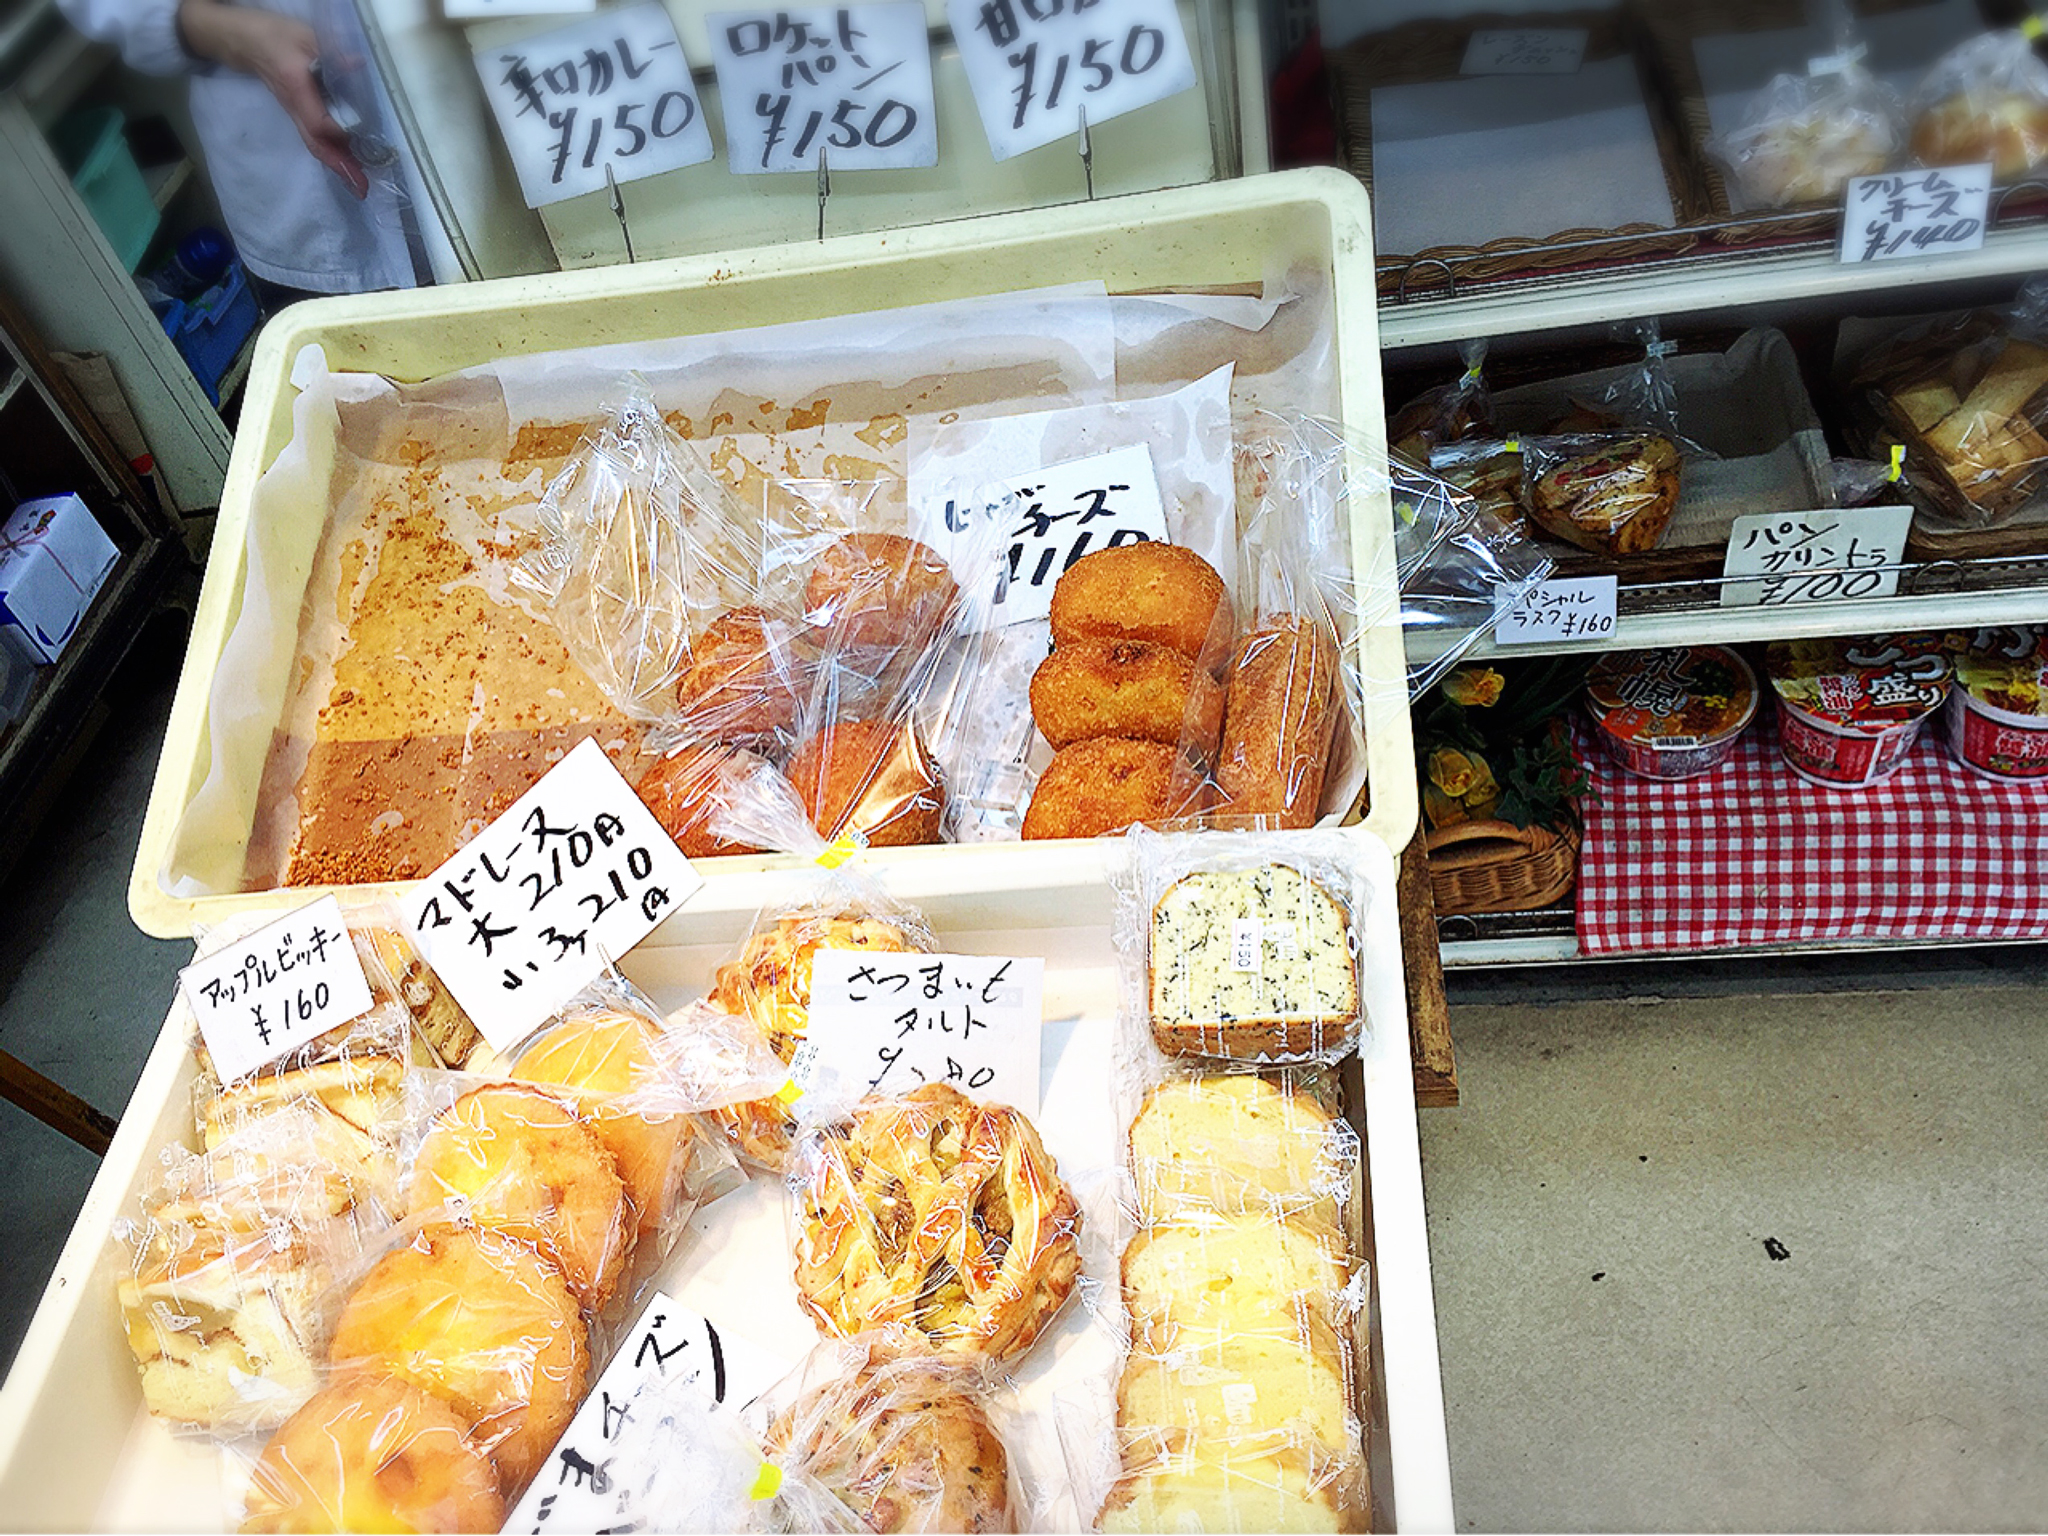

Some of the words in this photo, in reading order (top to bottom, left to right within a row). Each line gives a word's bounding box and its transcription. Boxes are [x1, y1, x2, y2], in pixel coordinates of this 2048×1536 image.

[781, 54, 907, 90] パン
[1007, 24, 1165, 129] ¥150
[547, 91, 694, 184] ¥150
[755, 93, 917, 168] ¥150
[1859, 171, 1955, 203] クリーム
[1880, 186, 1984, 222] チーズ
[1861, 218, 1980, 262] ¥140
[1743, 521, 1840, 549] パン
[1513, 609, 1561, 628] ラスク
[1561, 612, 1613, 637] ¥160
[468, 912, 518, 958] 大
[848, 961, 1013, 1004] さつまいも
[894, 1004, 988, 1040] タルト
